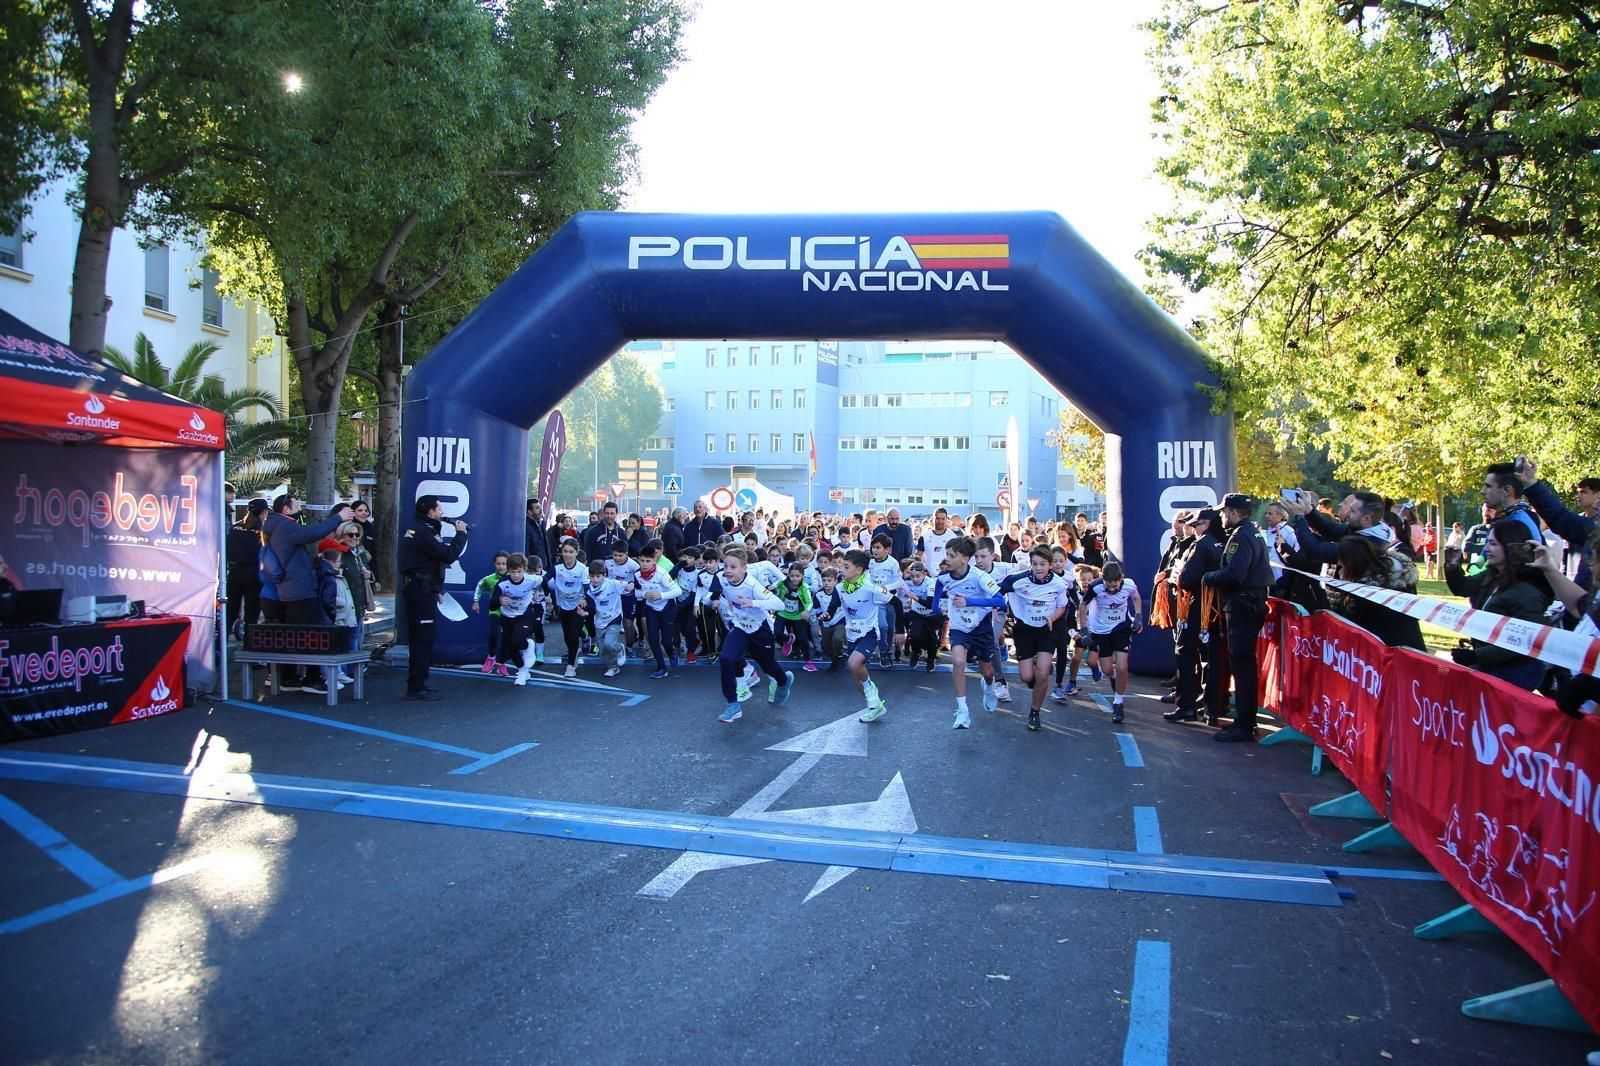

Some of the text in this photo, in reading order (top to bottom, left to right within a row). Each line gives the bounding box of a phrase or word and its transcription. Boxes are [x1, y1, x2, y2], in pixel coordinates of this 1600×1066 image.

[802, 270, 1009, 292] NACIONAL
[67, 412, 121, 430] Santander
[177, 428, 220, 444] Santander
[416, 436, 471, 475] RUTA
[1157, 440, 1217, 479] RUTA
[0, 635, 124, 692] Evedeport
[12, 702, 109, 723] www.evedeport.es
